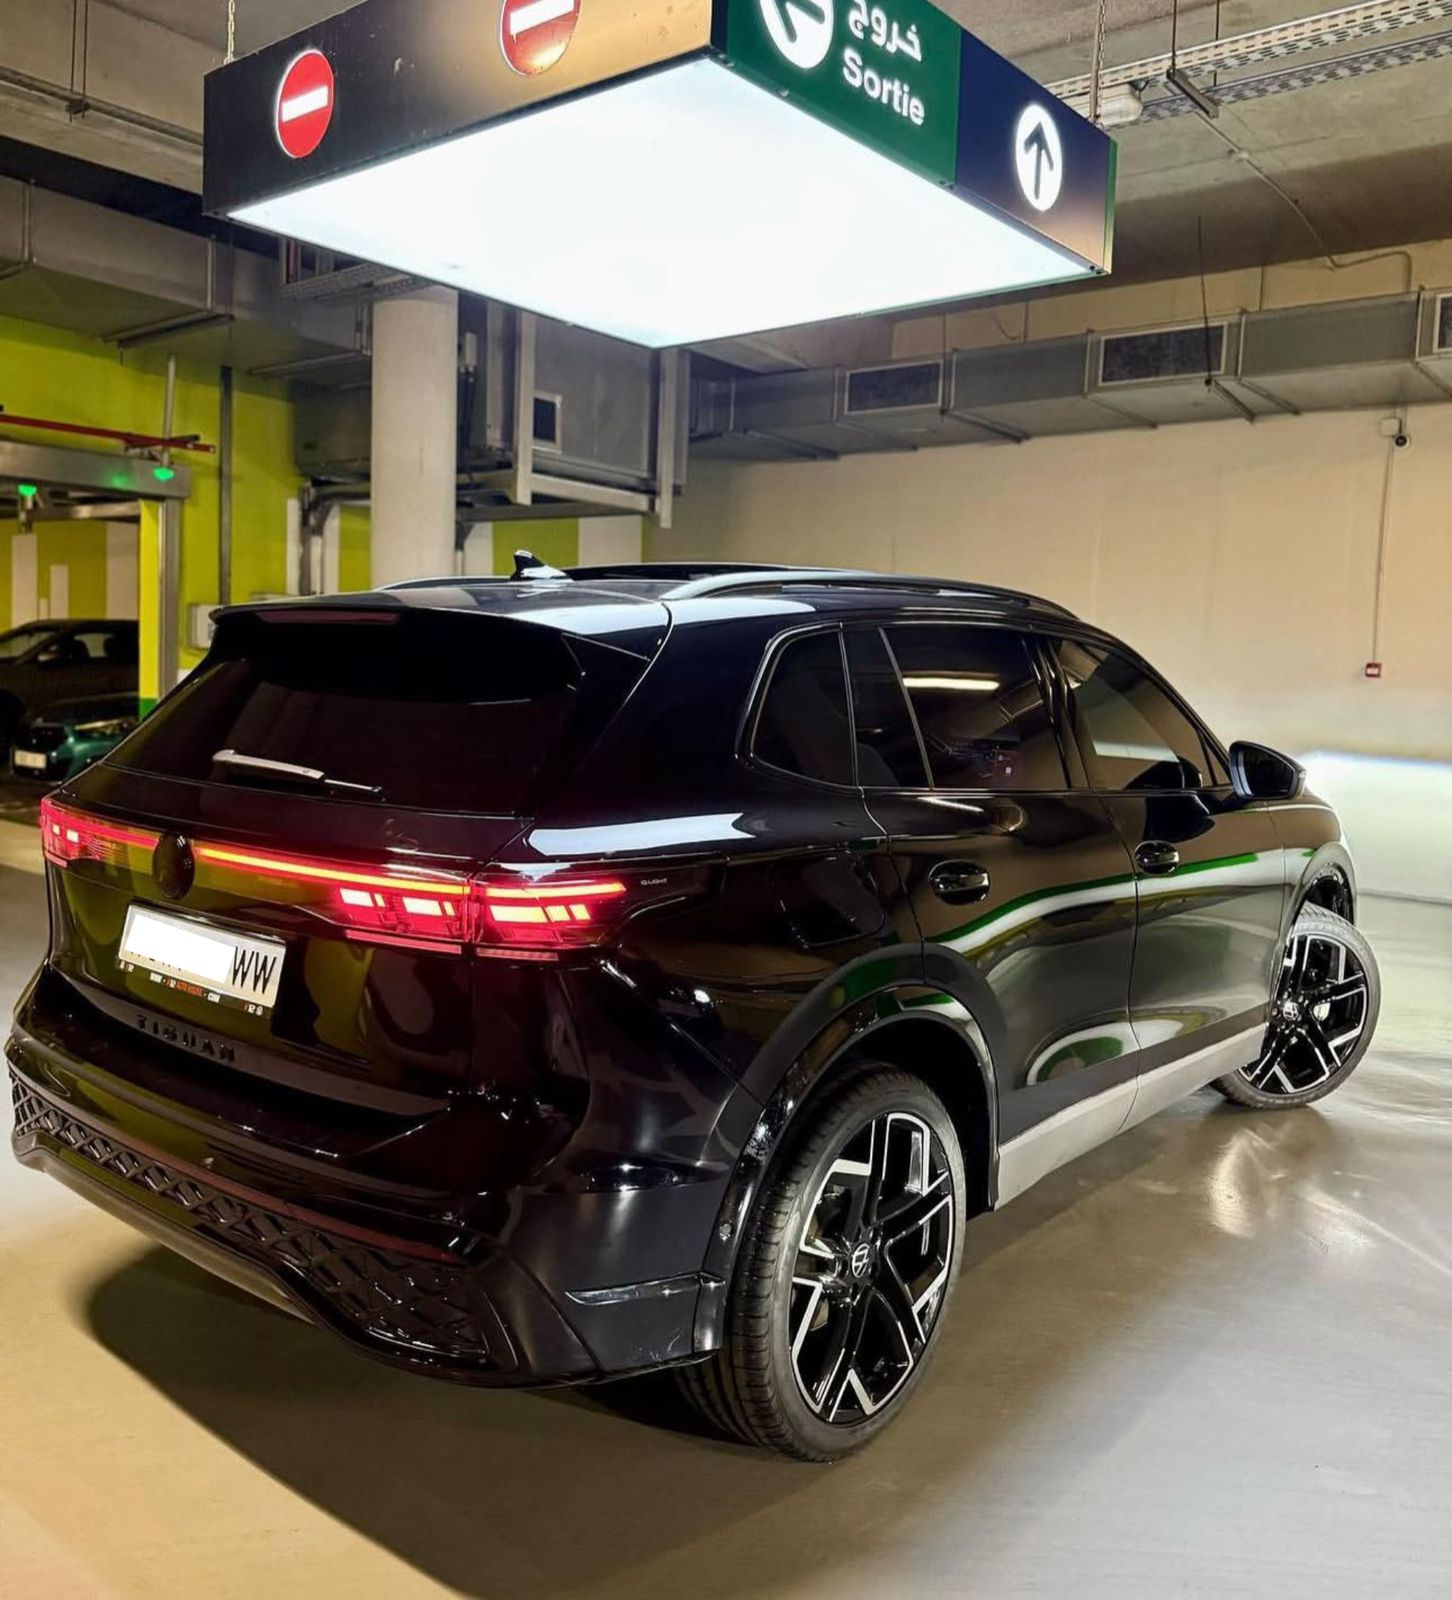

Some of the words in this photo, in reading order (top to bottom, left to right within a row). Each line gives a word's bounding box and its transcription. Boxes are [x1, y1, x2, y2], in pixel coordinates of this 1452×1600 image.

[848, 0, 922, 62] خروج
[843, 47, 925, 126] Sortie
[232, 946, 277, 995] WW
